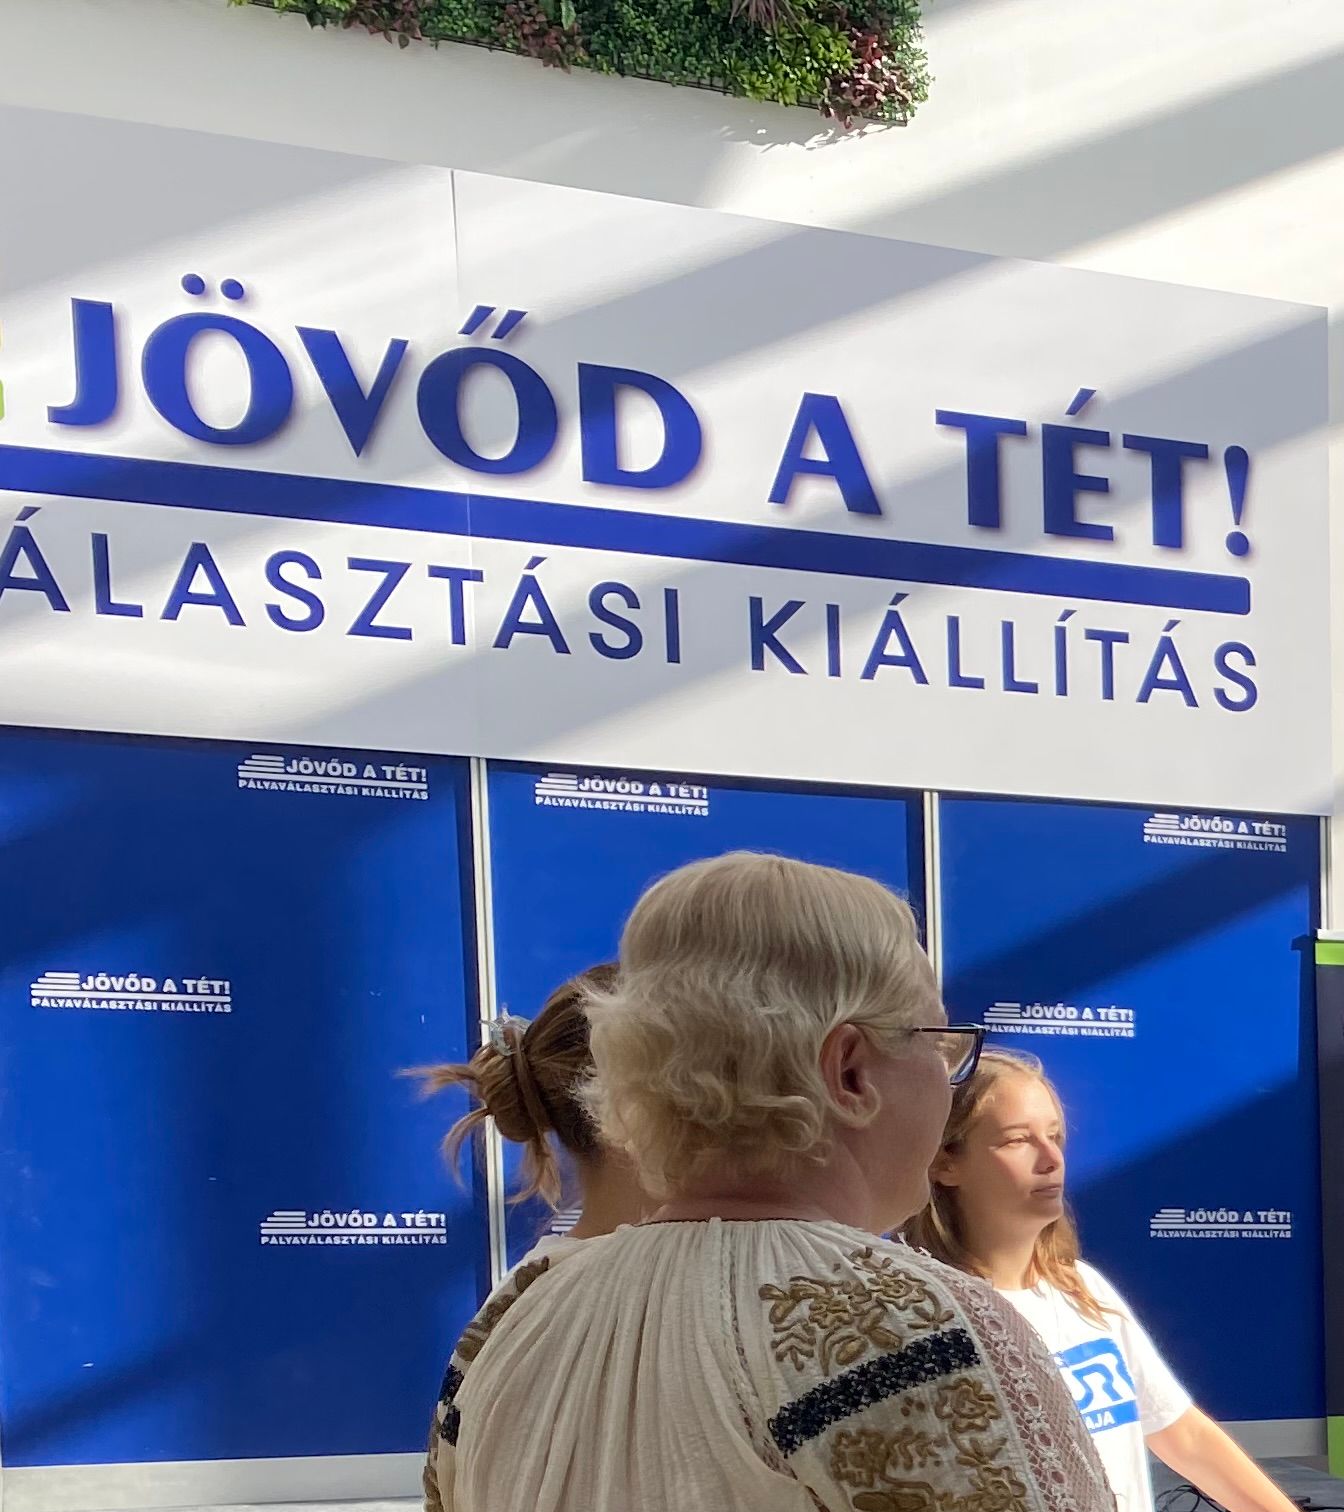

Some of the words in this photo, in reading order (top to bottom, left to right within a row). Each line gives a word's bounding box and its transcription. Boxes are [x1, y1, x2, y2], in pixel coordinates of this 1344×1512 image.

[47, 272, 702, 490] JÖVŐD
[767, 391, 883, 516] A
[935, 386, 1250, 557] TÉT!
[748, 592, 1258, 713] KIÁLLÍTÁS
[286, 757, 357, 777] JÖVŐD
[362, 764, 377, 778] A
[381, 763, 427, 782] TÉT!
[578, 775, 644, 794] JÖVŐD
[649, 782, 662, 796] A
[666, 781, 708, 799] TÉT!
[1179, 815, 1234, 833] JÖVŐD
[1237, 821, 1249, 834] A
[1251, 820, 1286, 837] TÉT!
[81, 973, 157, 993] JÖVŐD
[162, 978, 178, 993] A
[181, 976, 231, 995] TÉT!
[1021, 1002, 1079, 1020] JÖVŐD
[1081, 1007, 1095, 1021] A
[1096, 1005, 1134, 1022] TÉT!
[308, 1209, 378, 1228] JÖVŐD
[382, 1213, 397, 1228] A
[400, 1209, 447, 1228] TÉT!
[1185, 1207, 1240, 1223] JÖVŐD
[1242, 1211, 1254, 1223] A
[1256, 1208, 1292, 1223] TÉT!
